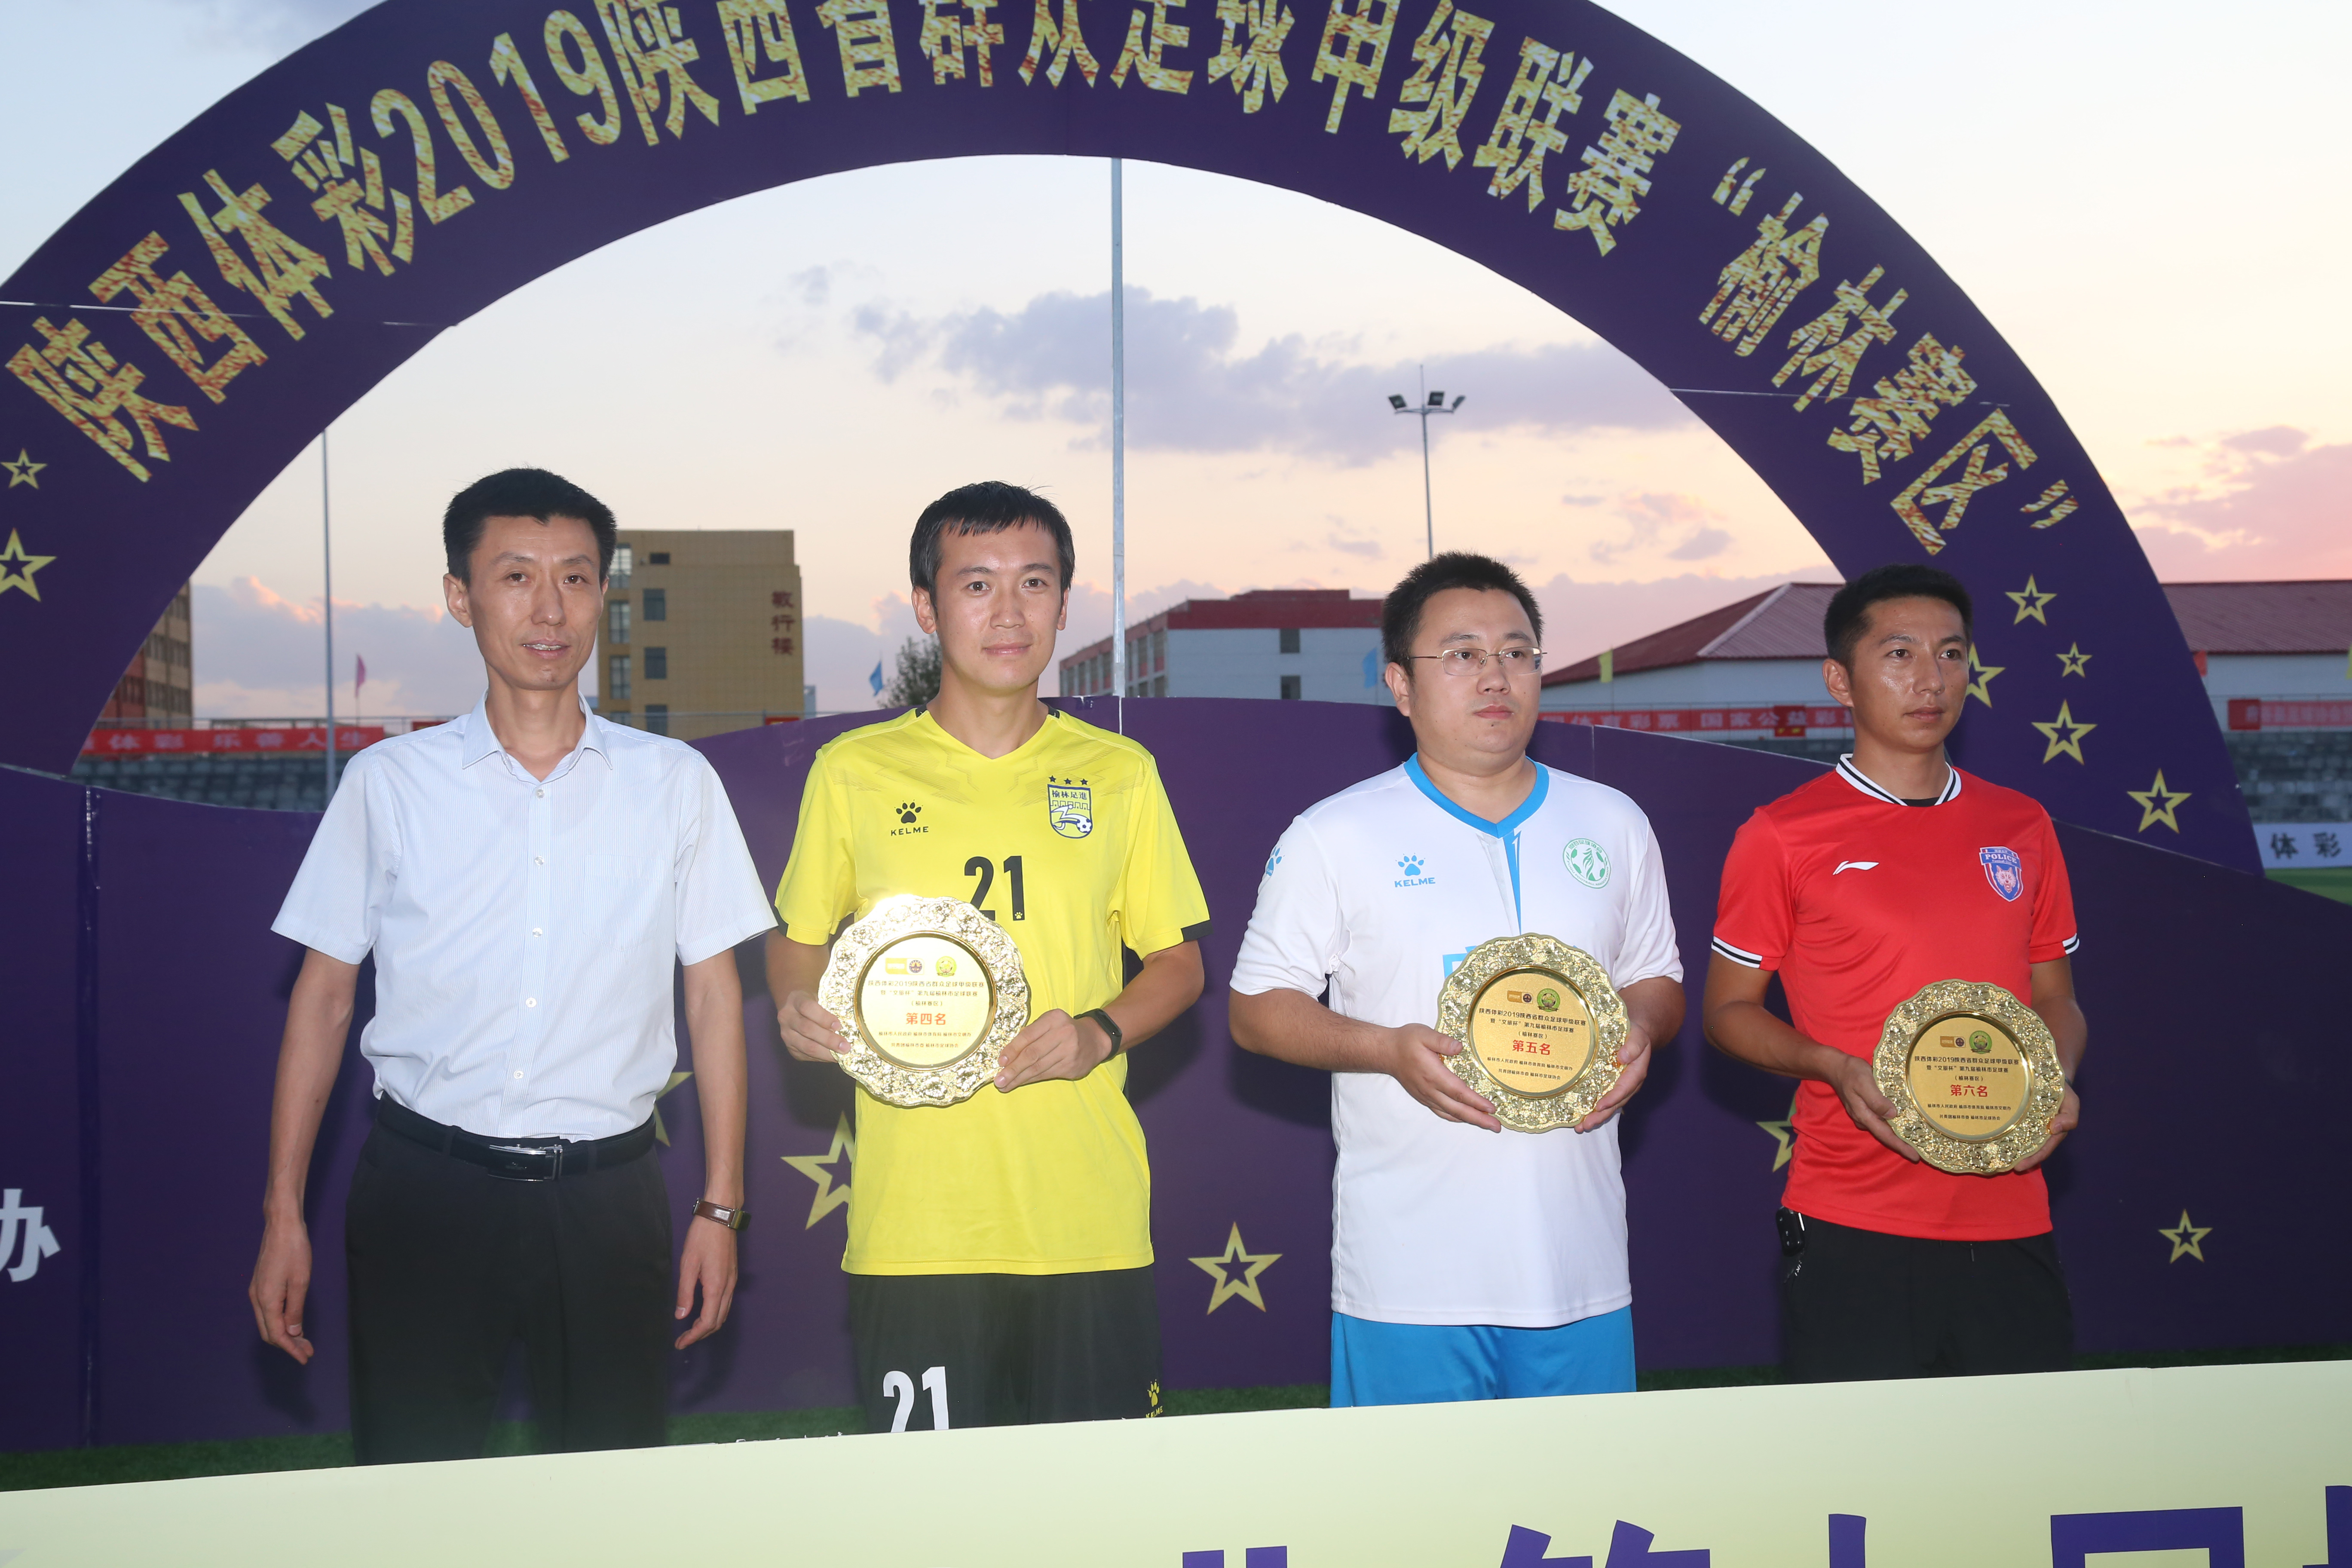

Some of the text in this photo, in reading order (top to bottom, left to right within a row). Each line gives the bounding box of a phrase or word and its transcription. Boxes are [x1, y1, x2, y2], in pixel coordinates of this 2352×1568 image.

[890, 825, 929, 837] KELME
[2270, 832, 2342, 859] 体彩
[1984, 853, 2017, 864] POLICE
[1394, 876, 1436, 888] KELME
[1574, 873, 1595, 886] FOOTBALL
[964, 855, 1025, 922] 21
[906, 1012, 946, 1025] 第四名
[1479, 1008, 1586, 1026] 陕西体彩2019陕西省群众足球甲级联赛
[1512, 1039, 1551, 1056] 第五名
[1914, 1056, 2019, 1065] 陕西体彩2019陕西省群众足球甲级联赛
[1950, 1084, 1988, 1097] 第六名
[883, 1366, 949, 1433] 21
[1145, 1405, 1164, 1418] KELME
